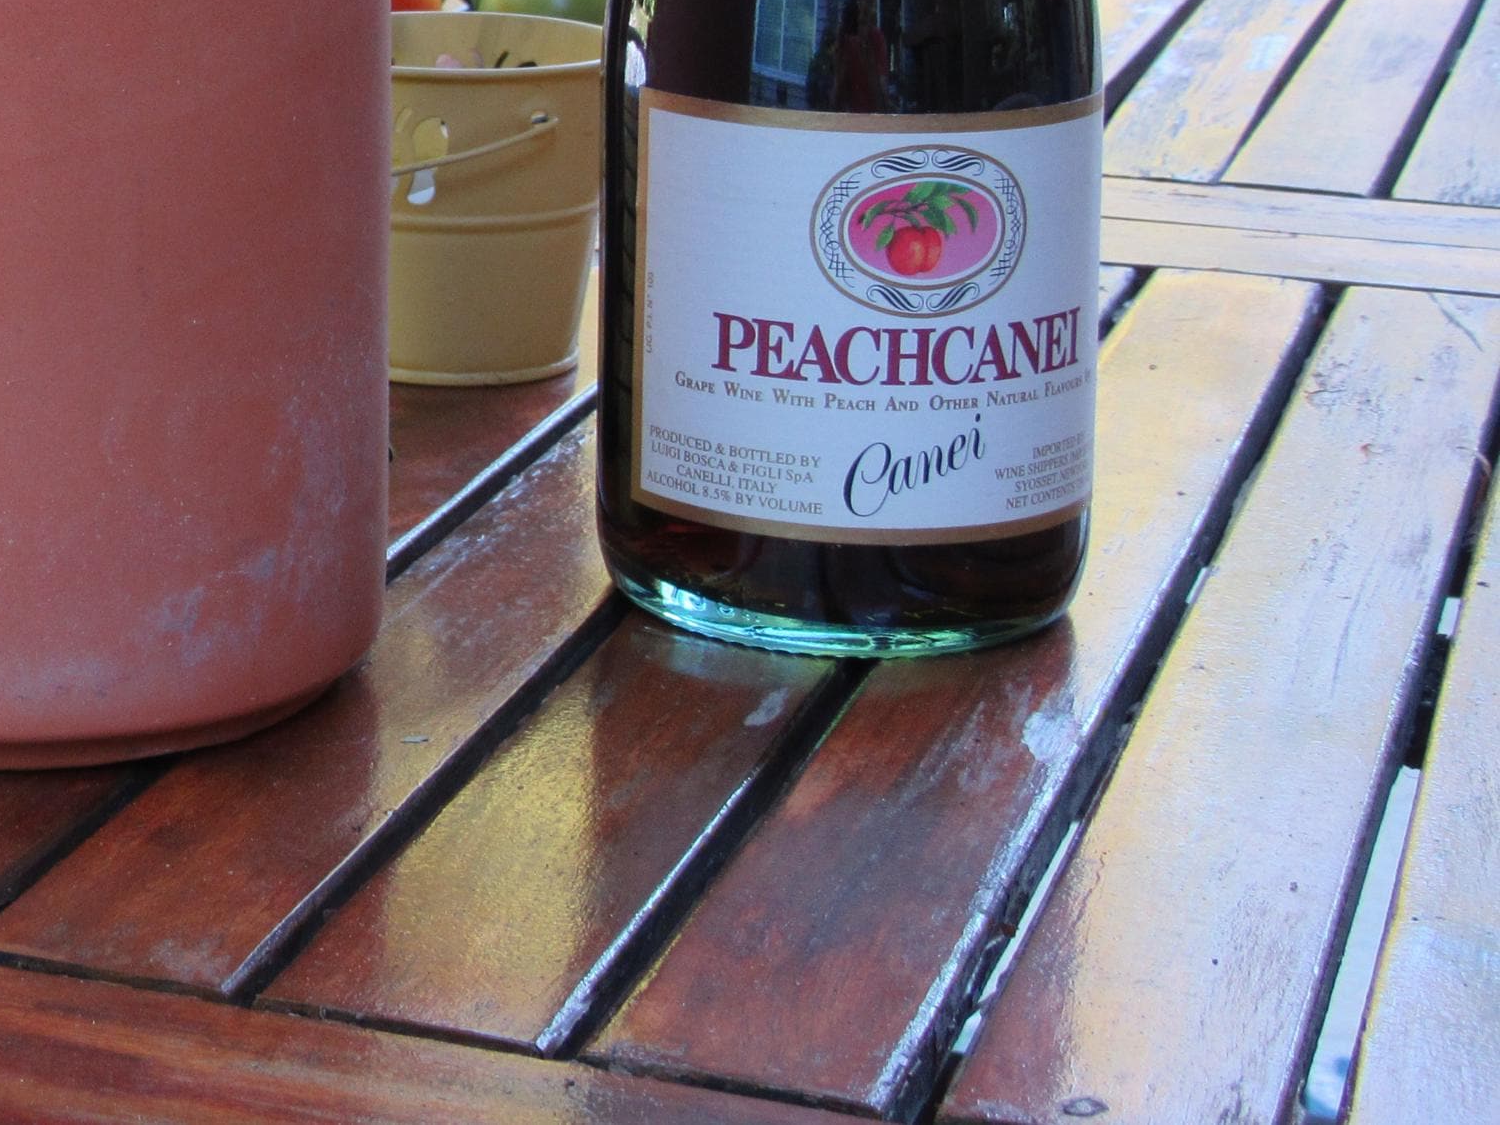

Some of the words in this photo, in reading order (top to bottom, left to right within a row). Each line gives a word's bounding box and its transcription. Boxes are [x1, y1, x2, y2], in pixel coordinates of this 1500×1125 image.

[711, 306, 1081, 386] PEACHCANEI
[650, 424, 712, 452] PRODUCED
[715, 442, 726, 455] &
[729, 445, 796, 466] BOTTLED
[800, 453, 821, 469] BY
[651, 441, 681, 460] LUIGI
[684, 450, 726, 471] BOSCA
[728, 461, 739, 474] &
[743, 463, 782, 480] FIGLI
[843, 412, 986, 517] Canei
[647, 469, 700, 495] ALCOHOL
[702, 485, 731, 502] 8.5%
[735, 492, 755, 507] BY
[758, 496, 823, 515] VOLUME
[738, 477, 778, 495] ITALY
[995, 464, 1026, 481] WINE
[1005, 495, 1029, 510] NET
